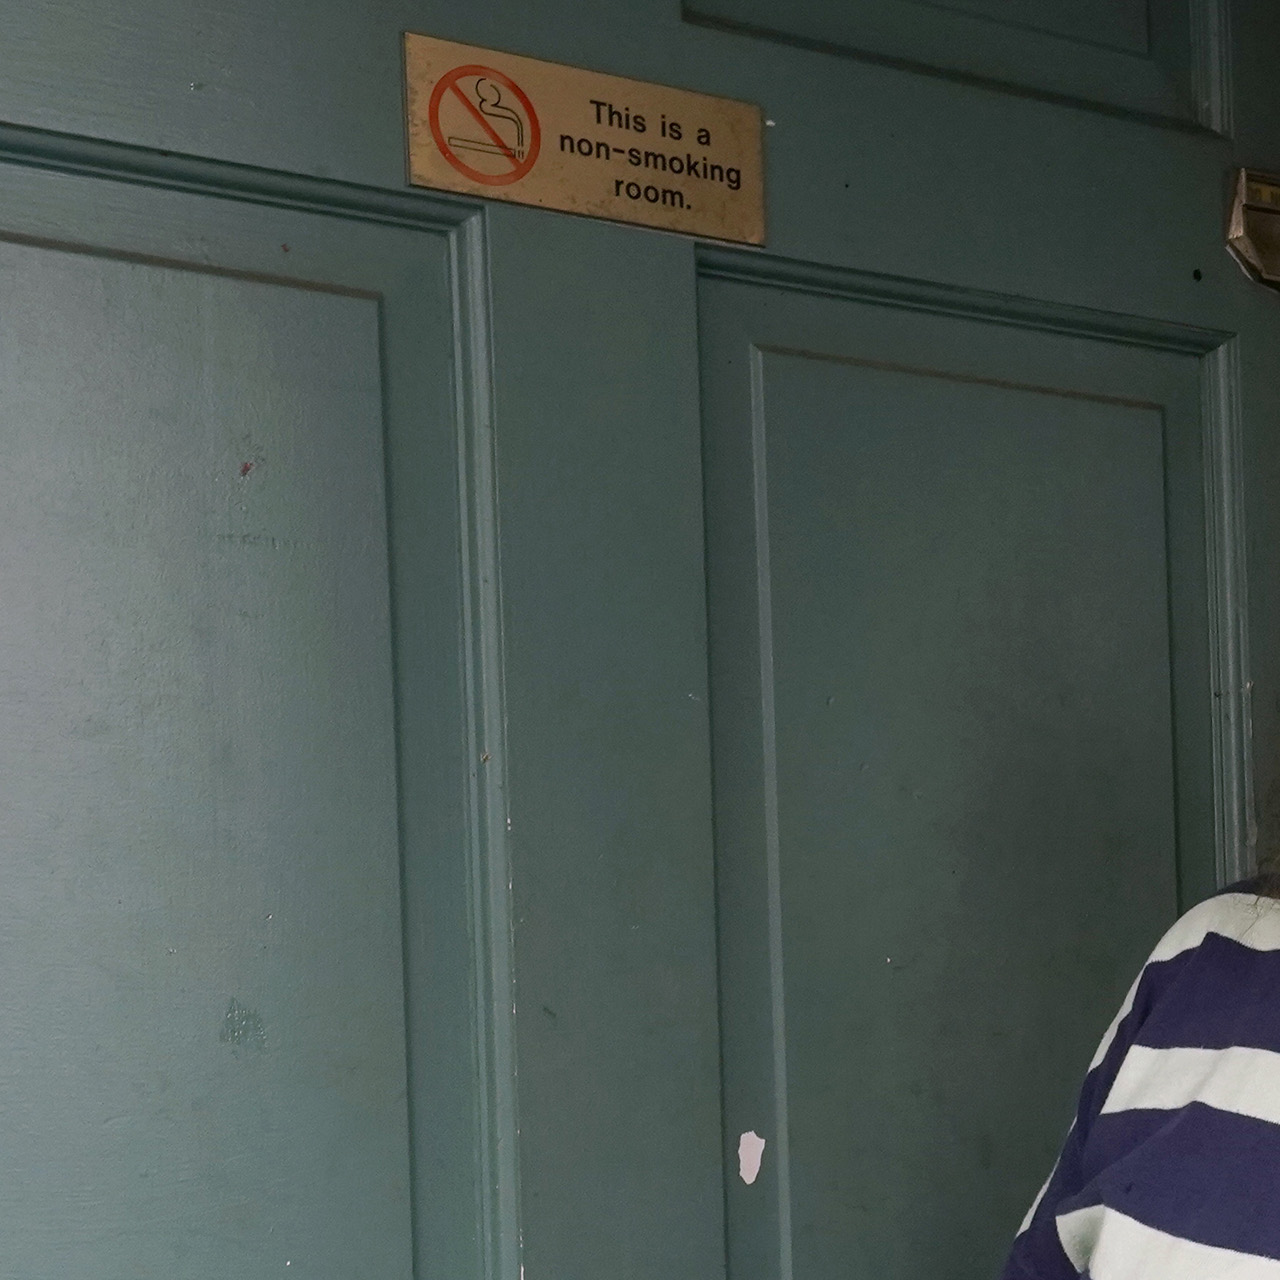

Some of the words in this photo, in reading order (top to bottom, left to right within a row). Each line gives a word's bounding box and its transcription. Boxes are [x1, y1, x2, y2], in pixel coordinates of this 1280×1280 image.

[590, 99, 647, 133] This
[660, 114, 683, 141] is
[697, 128, 711, 147] a
[560, 134, 742, 191] non-smoking
[614, 179, 692, 210] room.
